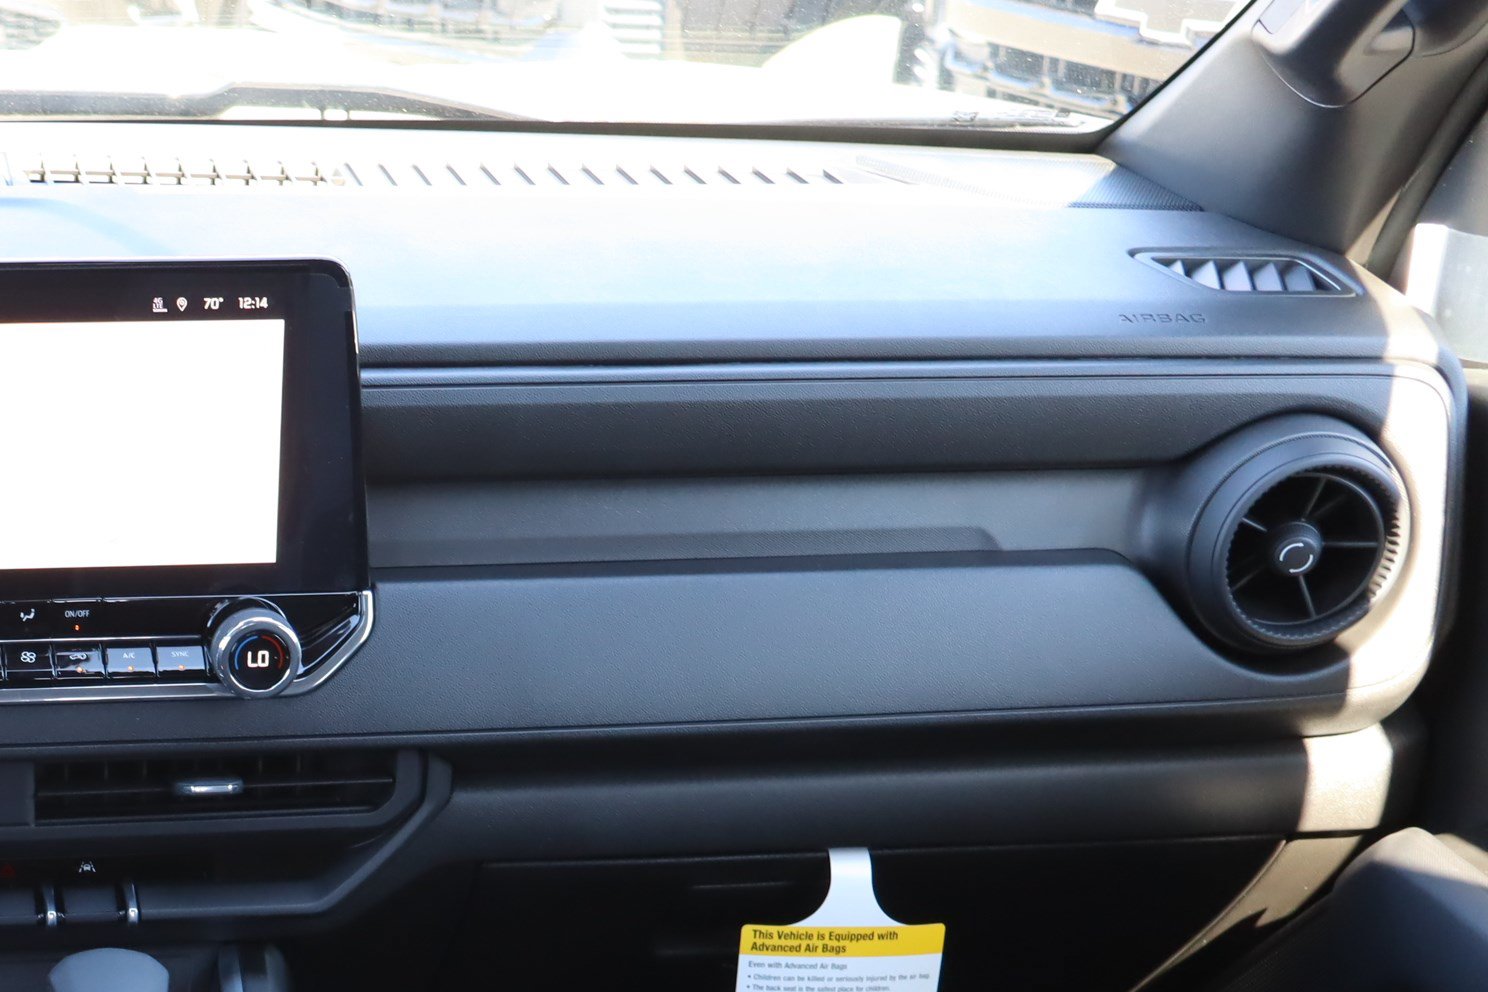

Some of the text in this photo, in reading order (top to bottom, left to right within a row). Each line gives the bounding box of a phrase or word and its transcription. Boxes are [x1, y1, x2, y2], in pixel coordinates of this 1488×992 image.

[202, 297, 269, 310] 70° 12:14
[1118, 313, 1206, 323] AIRBAG
[64, 610, 90, 618] ON/OFF
[122, 652, 136, 660] A/C
[171, 650, 190, 658] SYNC
[246, 651, 270, 668] LO
[753, 929, 898, 943] This Vehicle is Equipped with
[751, 942, 846, 955] Advanced Air Bags
[784, 962, 818, 970] Advanced
[832, 963, 848, 972] Bags
